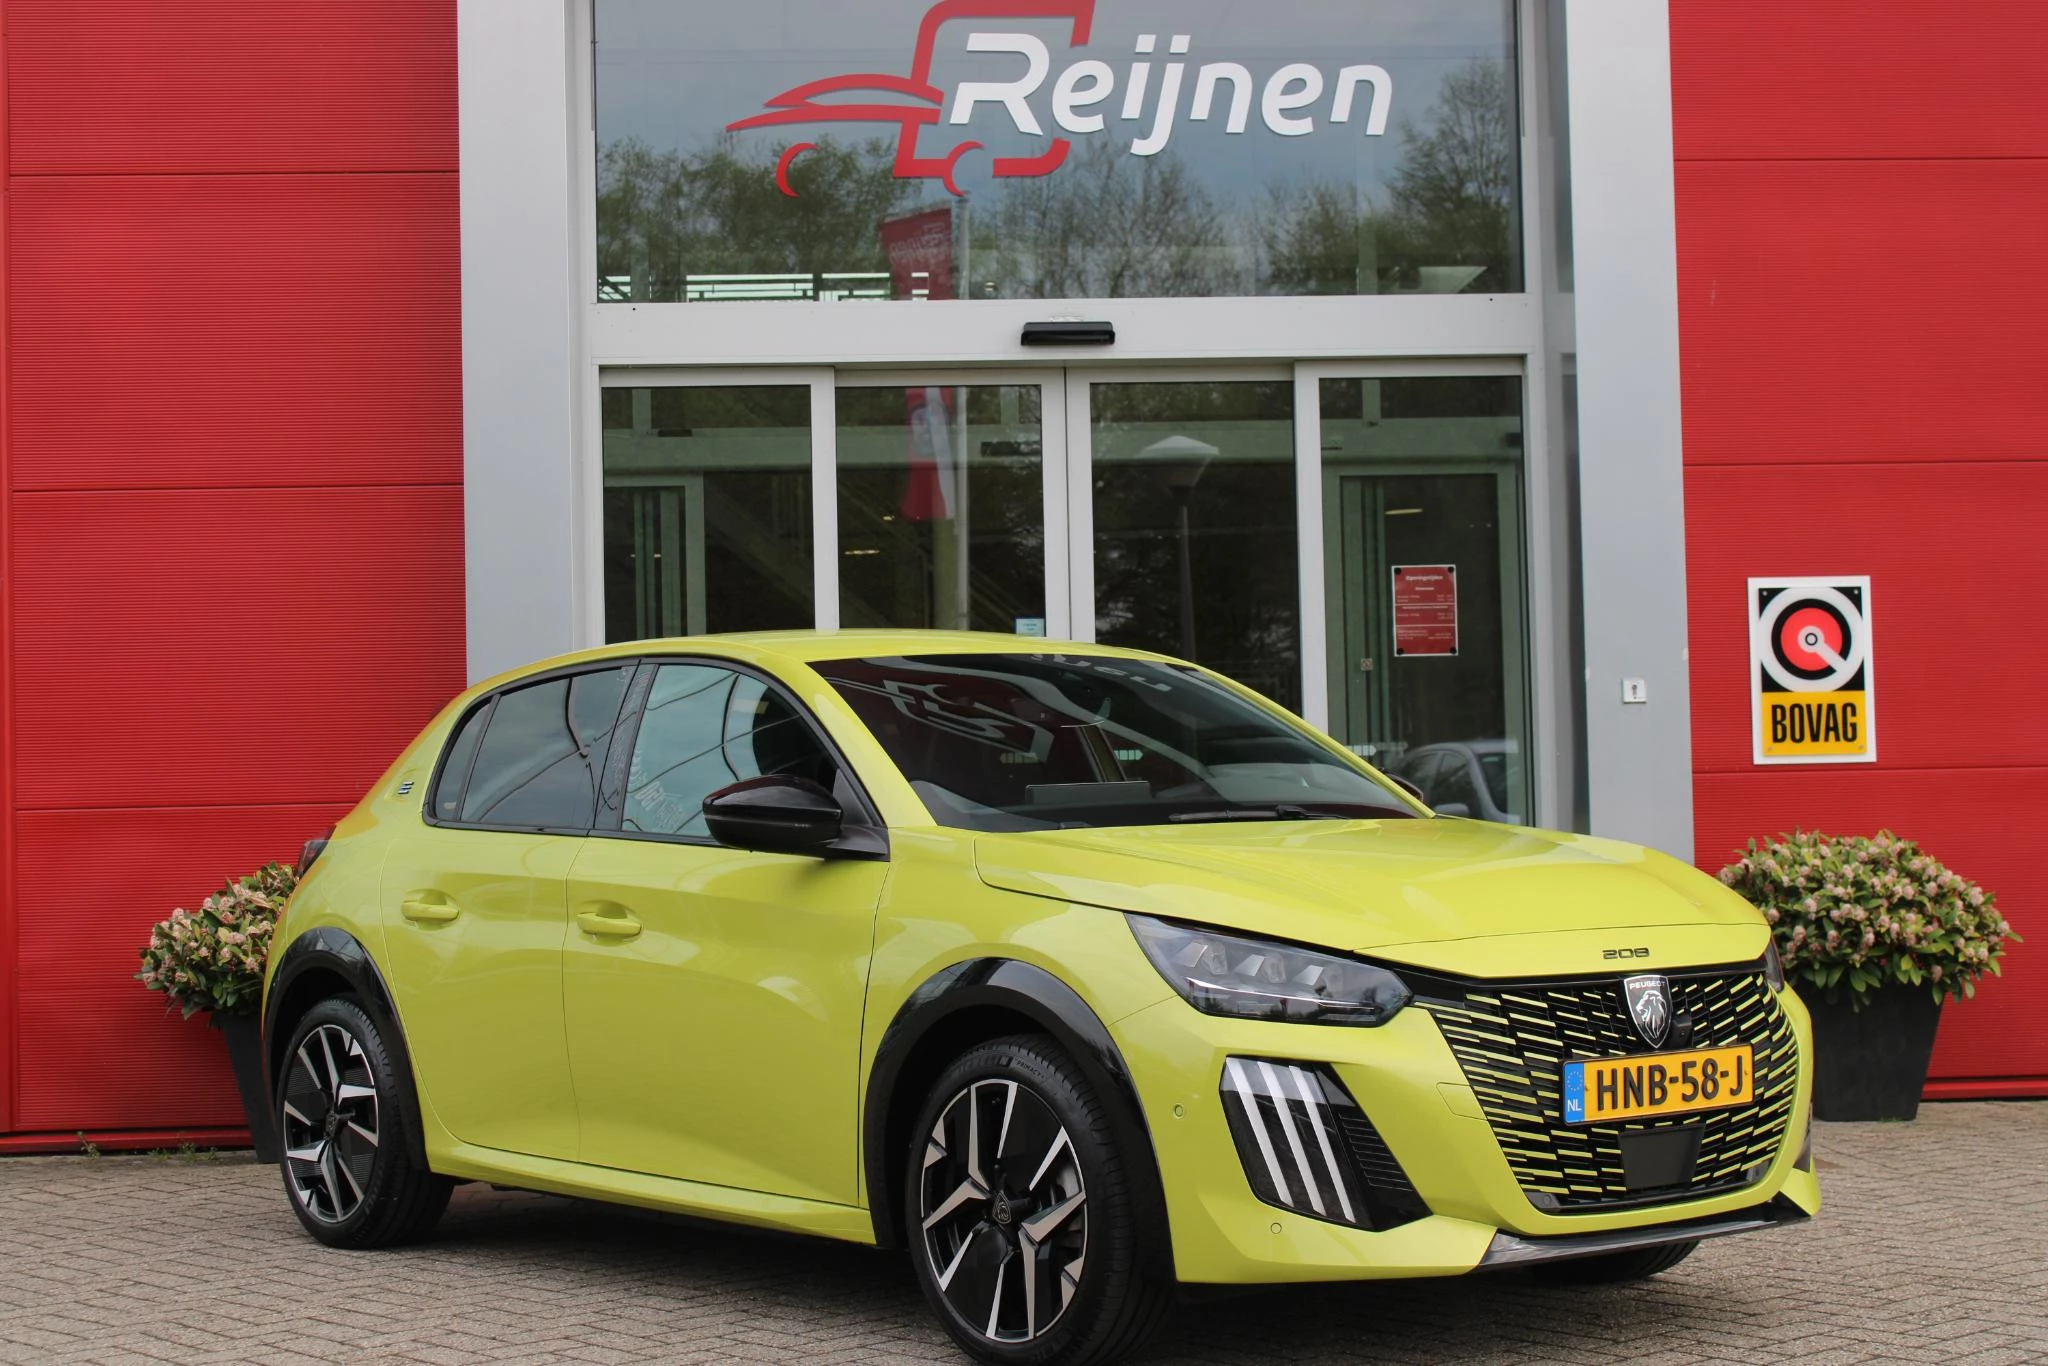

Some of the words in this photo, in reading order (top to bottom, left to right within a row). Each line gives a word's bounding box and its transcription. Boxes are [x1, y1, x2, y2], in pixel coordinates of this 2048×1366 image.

[949, 33, 1393, 156] Reijnen
[1771, 702, 1858, 743] BOVAG
[1602, 947, 1650, 960] 208
[1629, 980, 1666, 990] PEUGEOT
[1597, 1055, 1743, 1112] HNB-58-J
[1567, 1099, 1582, 1112] NL
